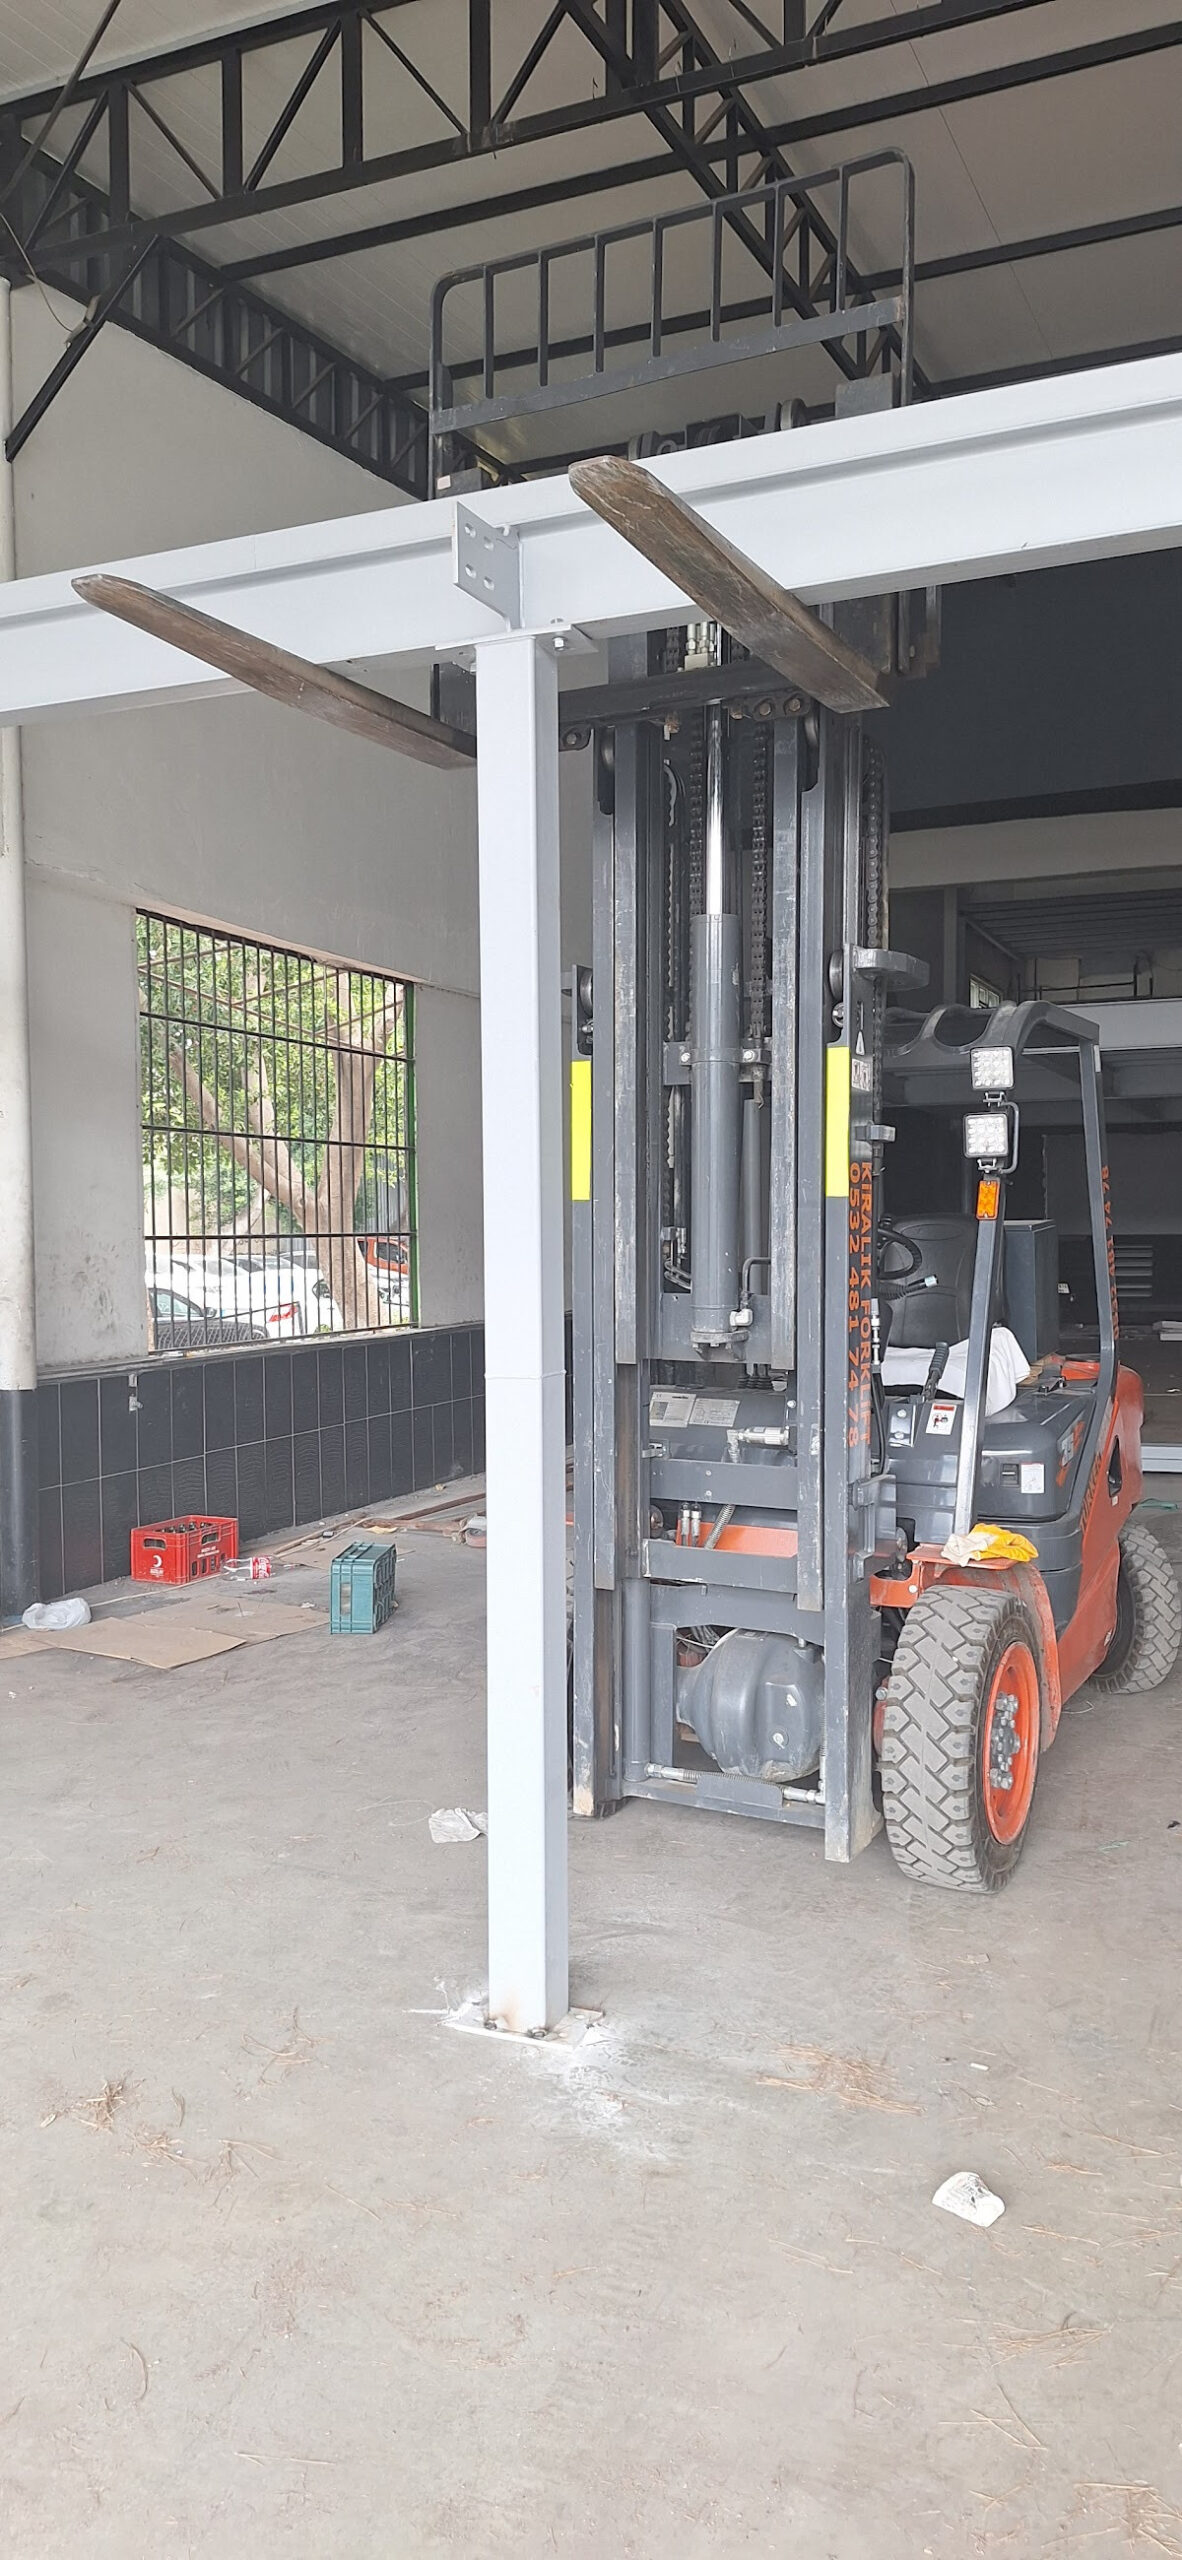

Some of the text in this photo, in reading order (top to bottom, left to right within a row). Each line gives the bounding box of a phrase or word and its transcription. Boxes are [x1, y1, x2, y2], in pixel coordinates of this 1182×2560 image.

[848, 1162, 860, 1447] 0532 481 74 78
